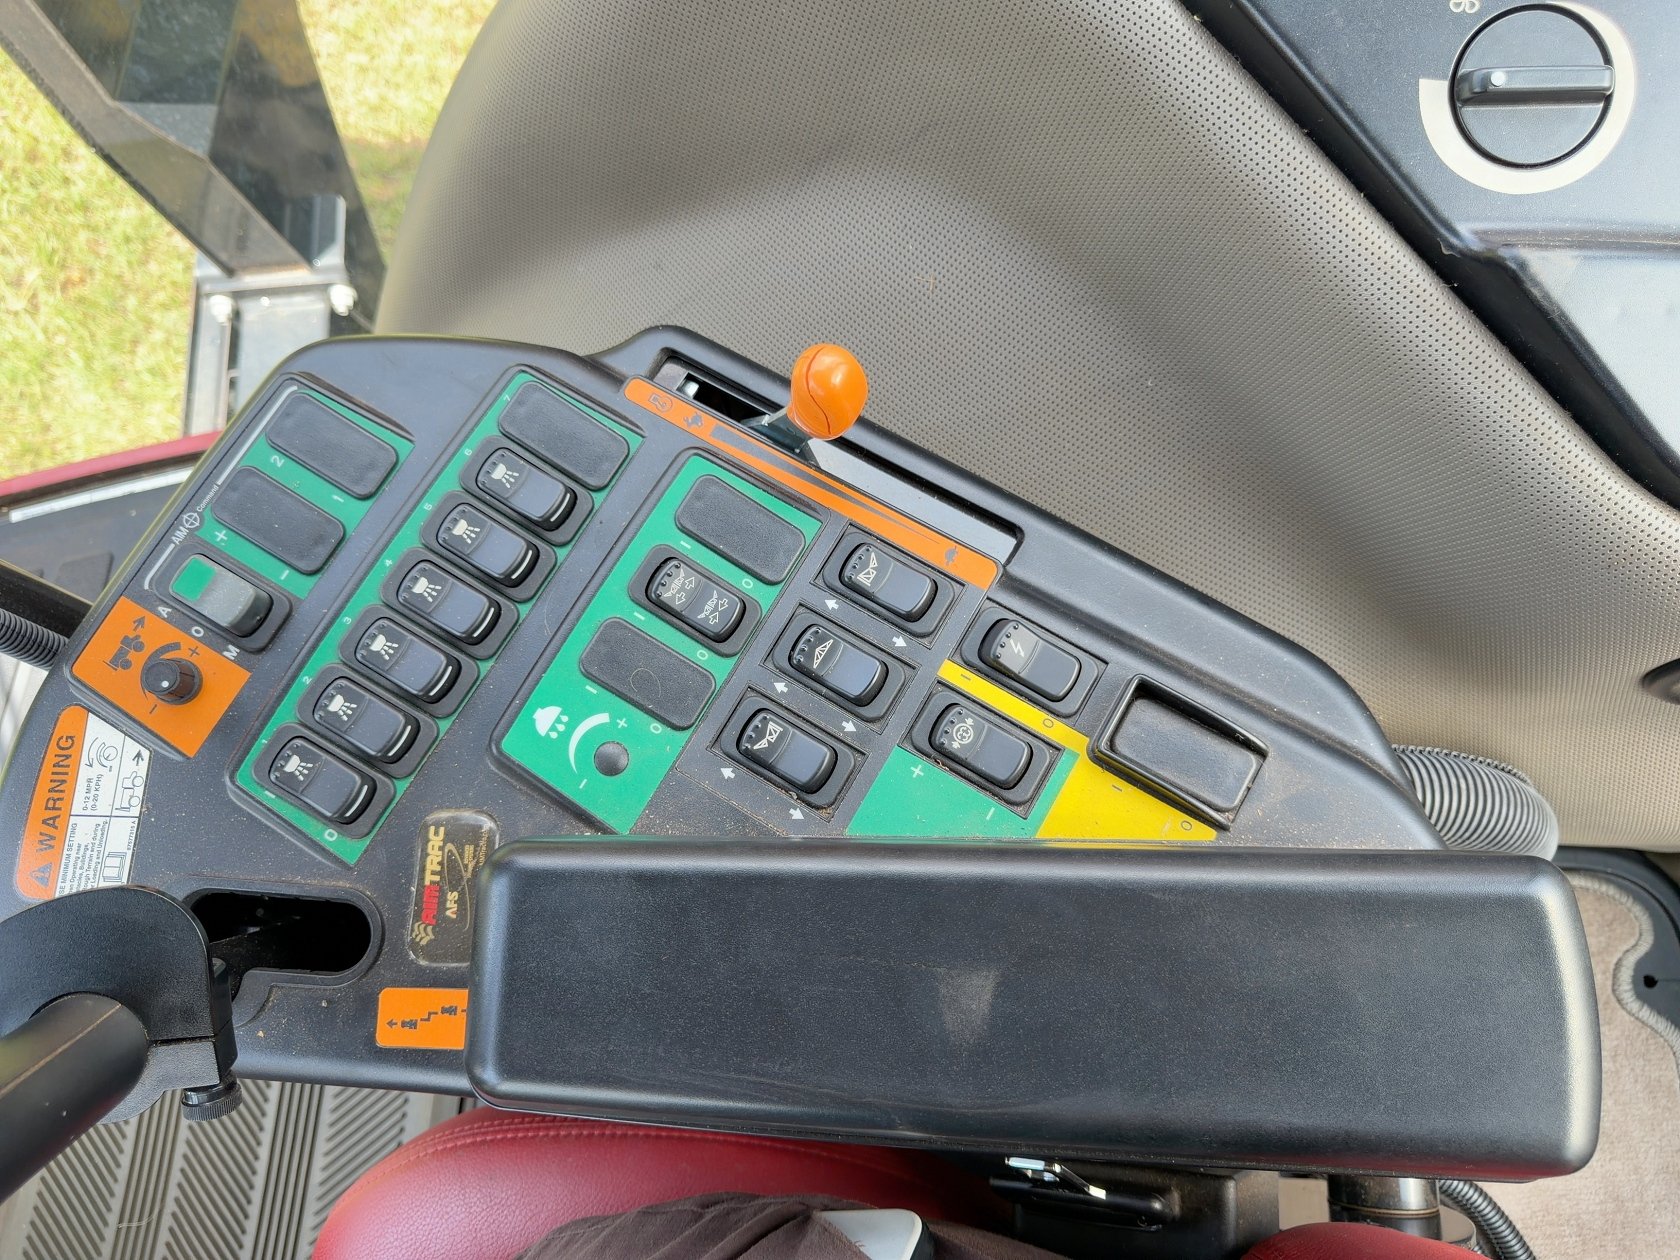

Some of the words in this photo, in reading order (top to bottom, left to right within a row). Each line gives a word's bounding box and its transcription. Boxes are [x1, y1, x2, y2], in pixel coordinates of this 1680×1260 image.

[270, 455, 285, 469] 2
[171, 526, 190, 545] AIM
[197, 484, 220, 512] Command
[157, 606, 172, 619] A
[222, 644, 241, 661] M
[36, 735, 76, 853] WARNING
[83, 796, 91, 811] 0-12
[66, 822, 78, 852] SETTING
[86, 853, 94, 871] Terrain
[92, 823, 101, 841] during
[61, 853, 72, 884] MINIMUM
[70, 856, 80, 882] Operating
[91, 861, 101, 884] Loading
[421, 825, 445, 925] AIMTRAC
[445, 891, 459, 919] AFS
